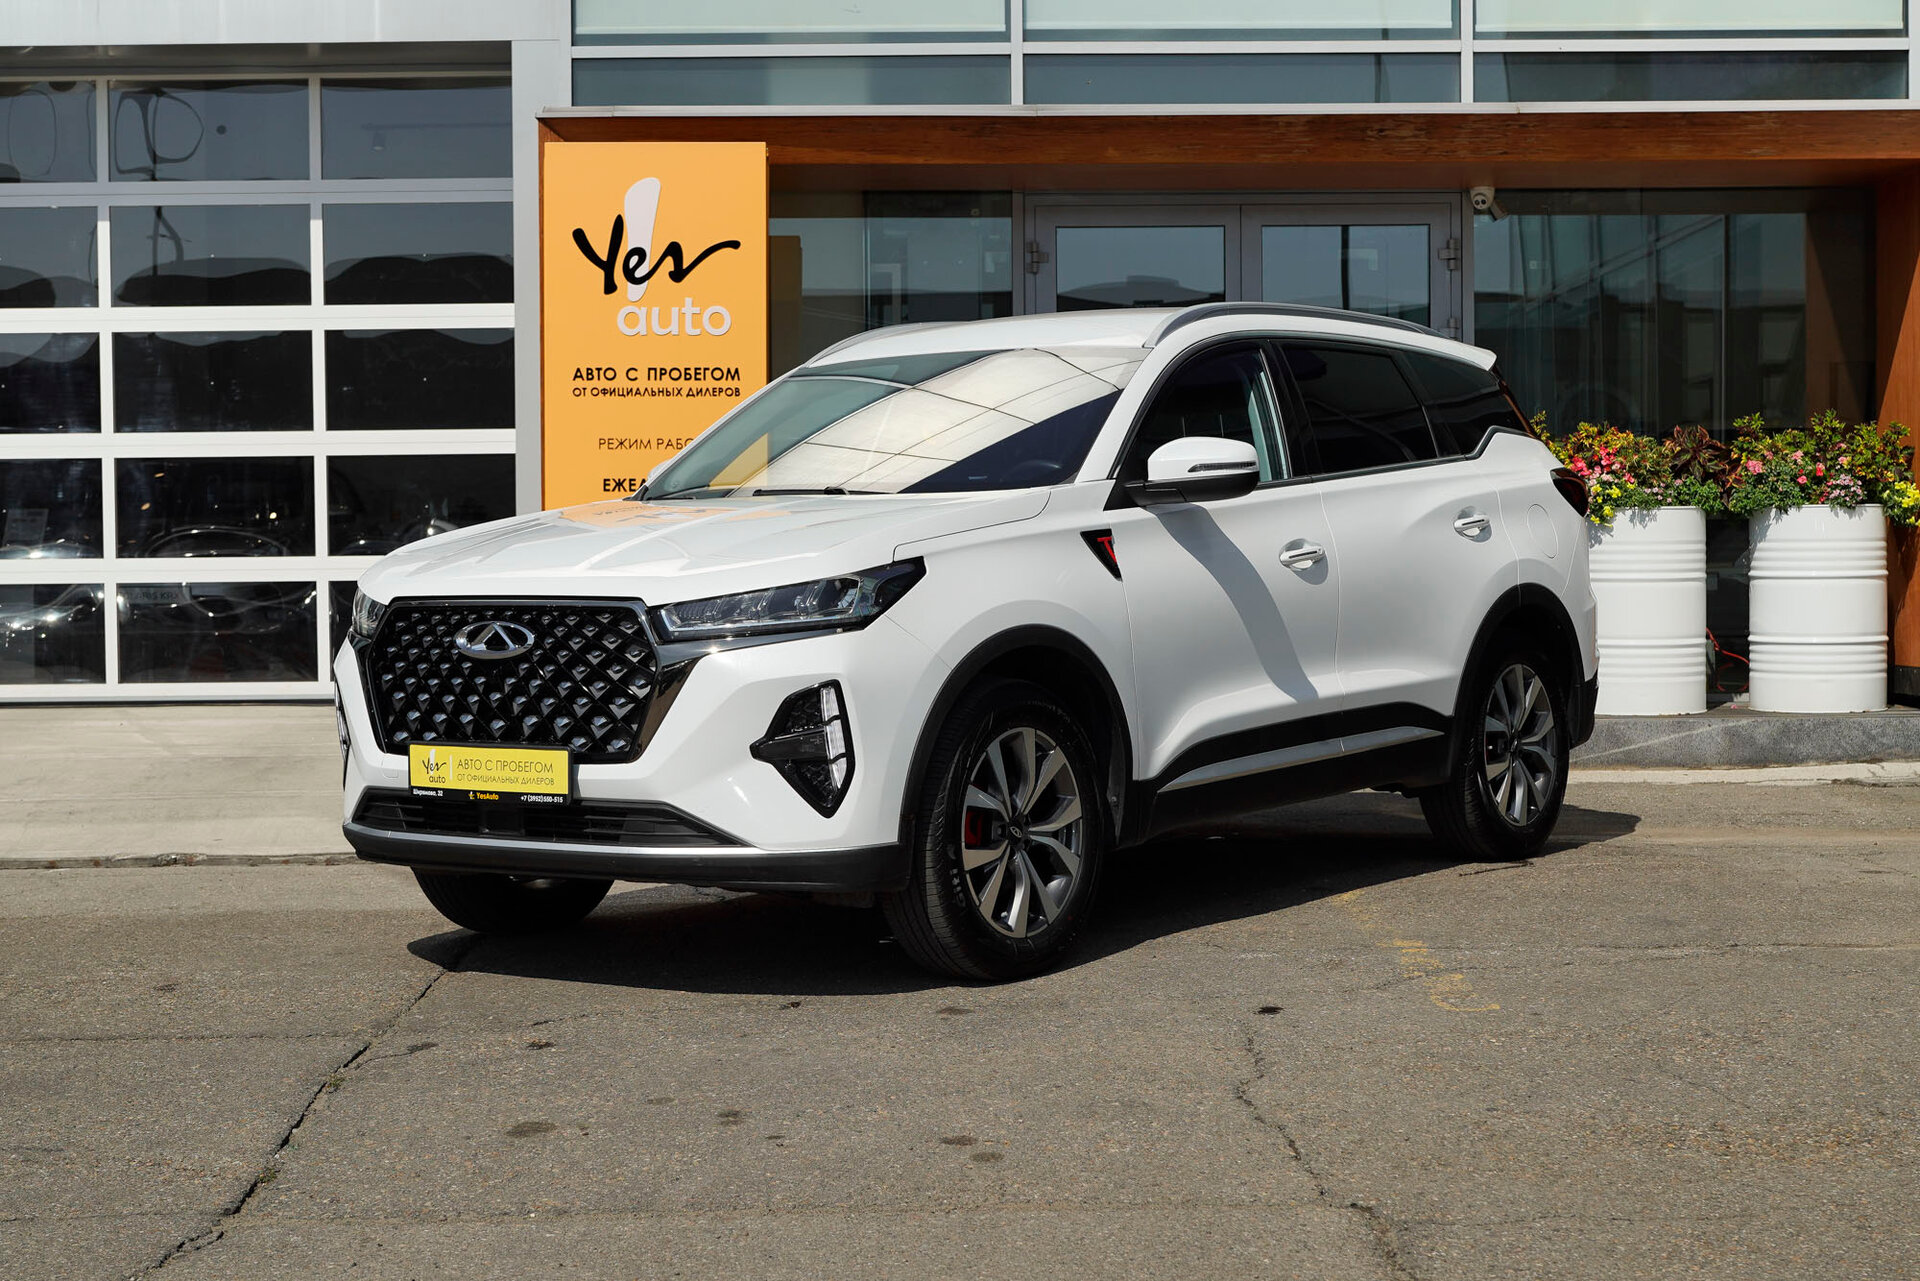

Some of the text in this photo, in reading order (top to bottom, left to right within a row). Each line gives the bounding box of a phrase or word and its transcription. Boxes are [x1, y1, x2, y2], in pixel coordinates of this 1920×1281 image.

[572, 214, 742, 295] Yes
[617, 297, 732, 336] auto
[573, 367, 741, 381] АВТО С ПРОБЕГОМ
[572, 387, 741, 398] ОТ ОФИЦИАЛЬНЫХ ДИЛЕРОВ
[598, 438, 651, 450] РЕЖИМ
[457, 758, 554, 774] АВТО С ПРОБЕГОМ
[429, 774, 447, 784] auto
[457, 773, 555, 786] ОТ ОФИЦИАЛЬНЫХ ДИЛЕРОВ
[476, 791, 499, 800] YesAuto
[520, 794, 527, 802] +7
